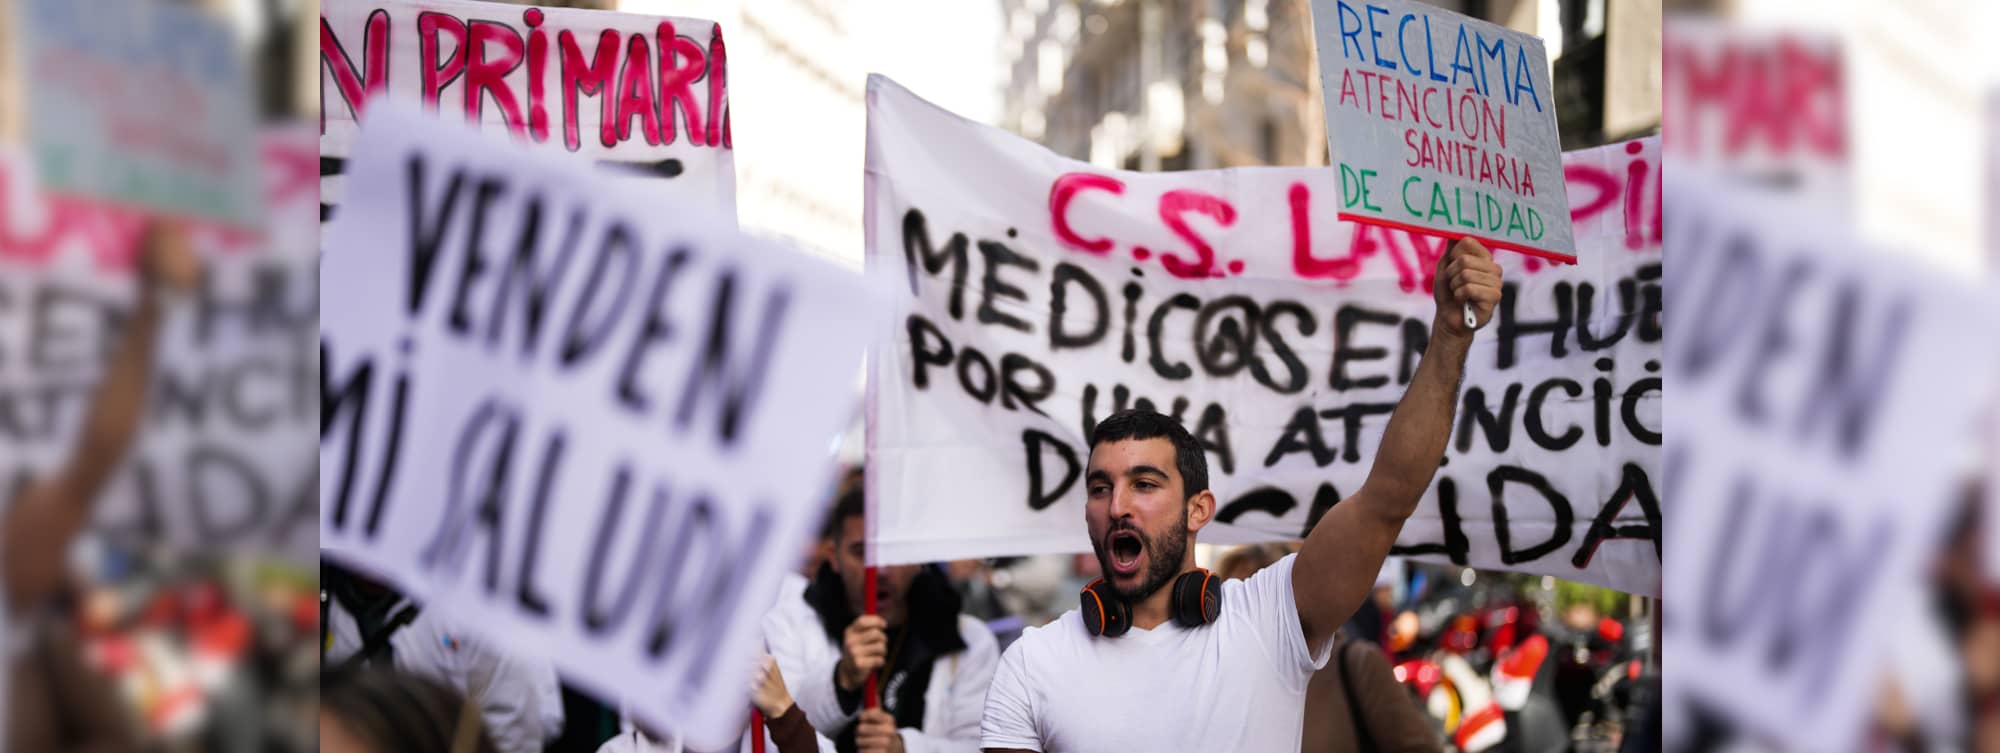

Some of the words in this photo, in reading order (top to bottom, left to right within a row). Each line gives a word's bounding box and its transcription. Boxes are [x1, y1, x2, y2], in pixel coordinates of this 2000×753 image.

[417, 7, 732, 153] PRIMARI
[1337, 0, 1541, 112] RECLAMA
[1339, 68, 1506, 149] ATENCIÓN
[1340, 163, 1382, 213] DE
[1402, 176, 1544, 241] CALIDAD
[1405, 129, 1536, 197] SANITARIA
[402, 148, 796, 450] VENDEN
[906, 314, 1056, 420] POR
